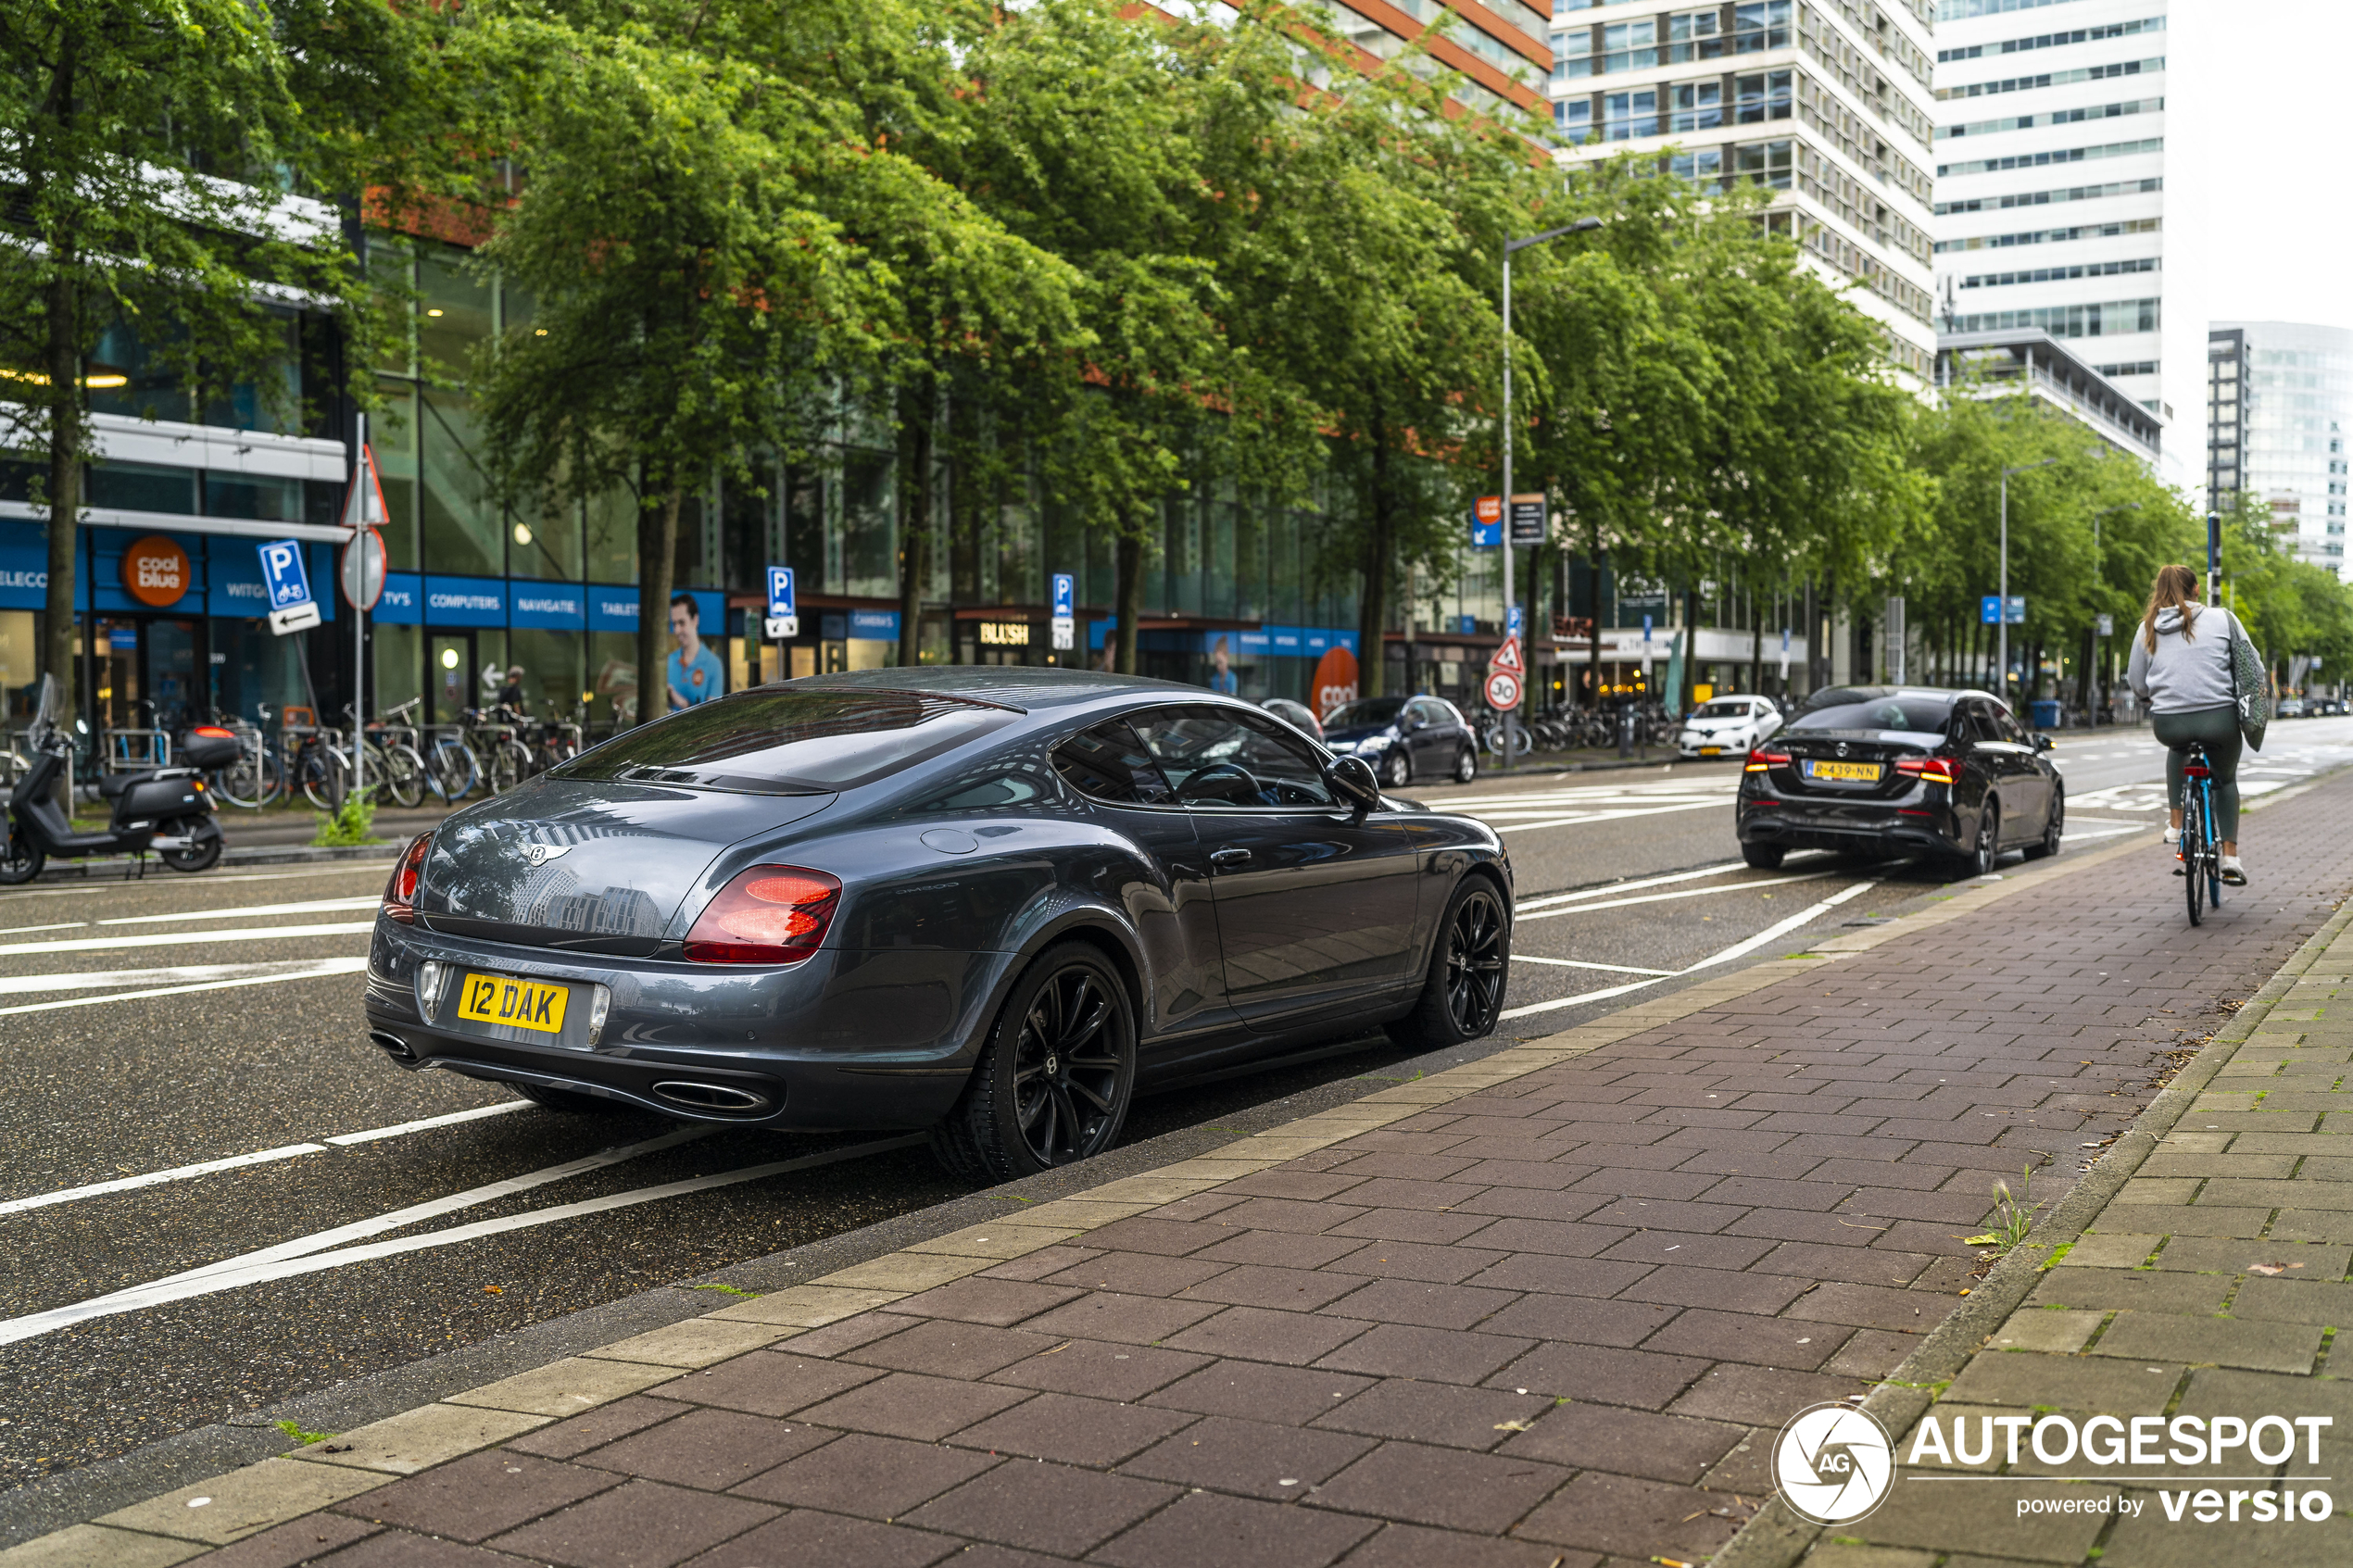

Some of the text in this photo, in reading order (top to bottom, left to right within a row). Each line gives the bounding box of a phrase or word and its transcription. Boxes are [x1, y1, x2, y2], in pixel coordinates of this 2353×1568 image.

[138, 556, 179, 572] cool
[270, 547, 292, 582] P
[138, 571, 180, 589] blue
[774, 572, 787, 597] P
[1058, 579, 1069, 600] P
[980, 622, 1029, 646] BLUSH
[1492, 682, 1515, 699] 30
[1816, 764, 1874, 776] R-439-NN
[470, 981, 557, 1024] 12 DAK
